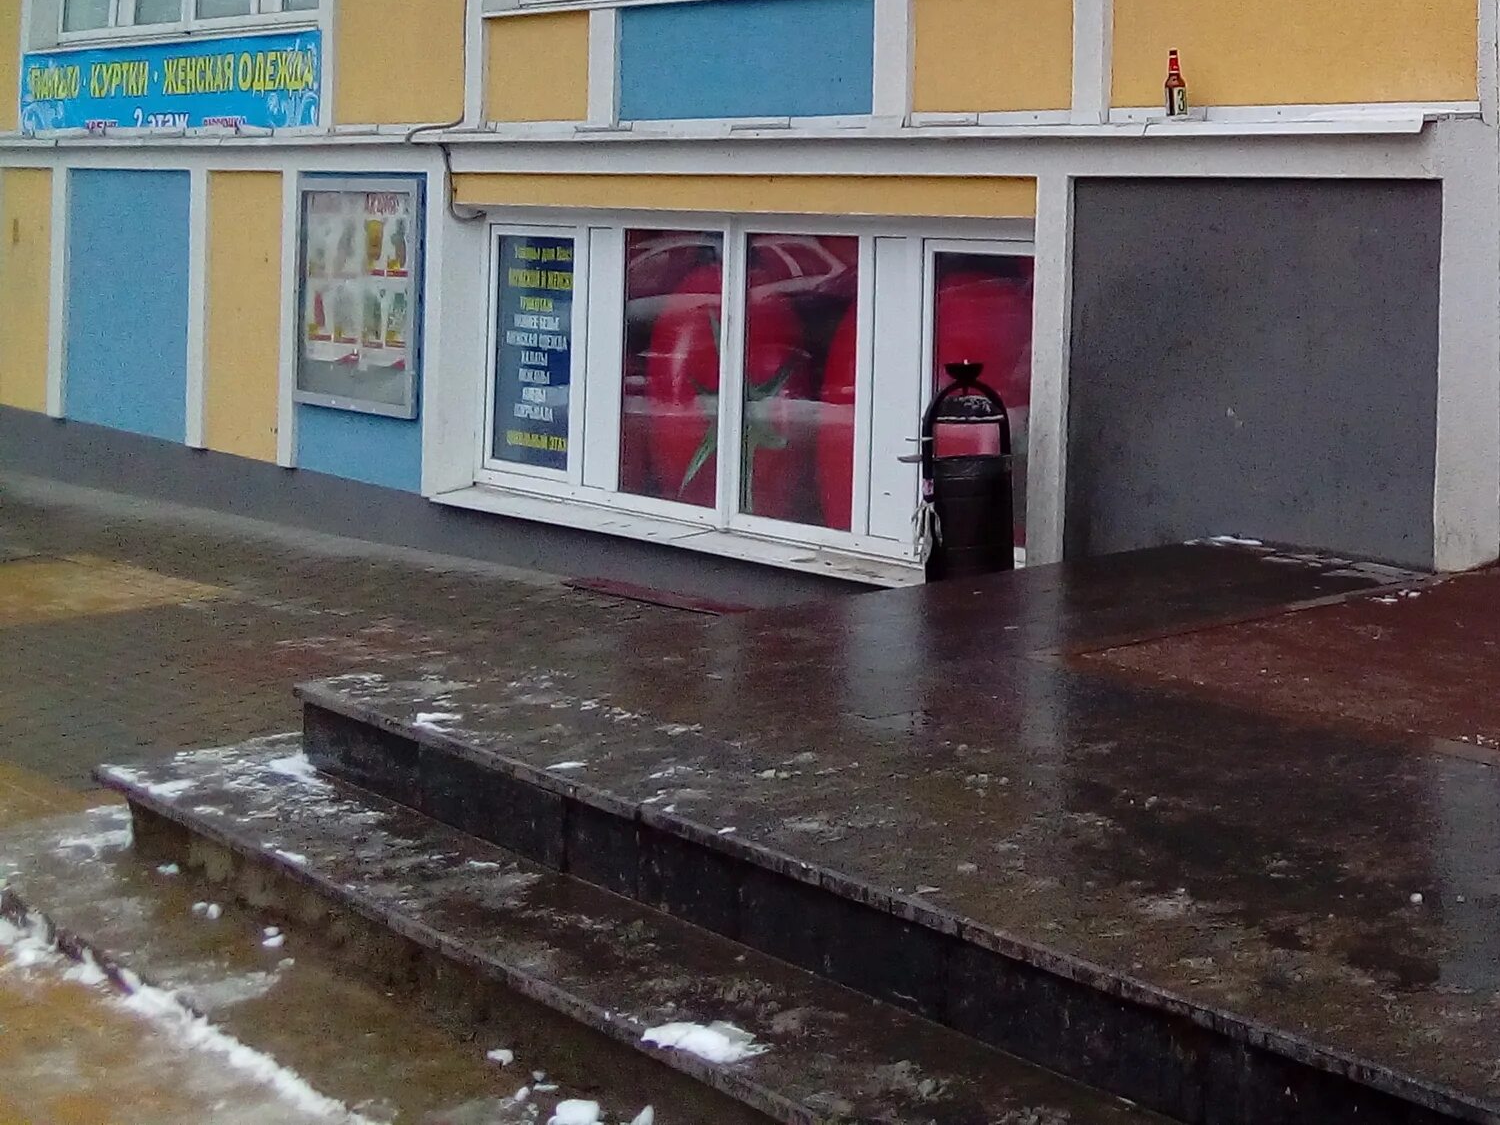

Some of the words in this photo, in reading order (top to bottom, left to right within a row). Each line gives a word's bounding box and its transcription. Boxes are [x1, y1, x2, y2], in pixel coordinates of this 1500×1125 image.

[90, 60, 148, 99] КУРТКИ
[163, 52, 233, 95] ЖЕНСКАЯ
[238, 49, 314, 96] ОДЕЖДА
